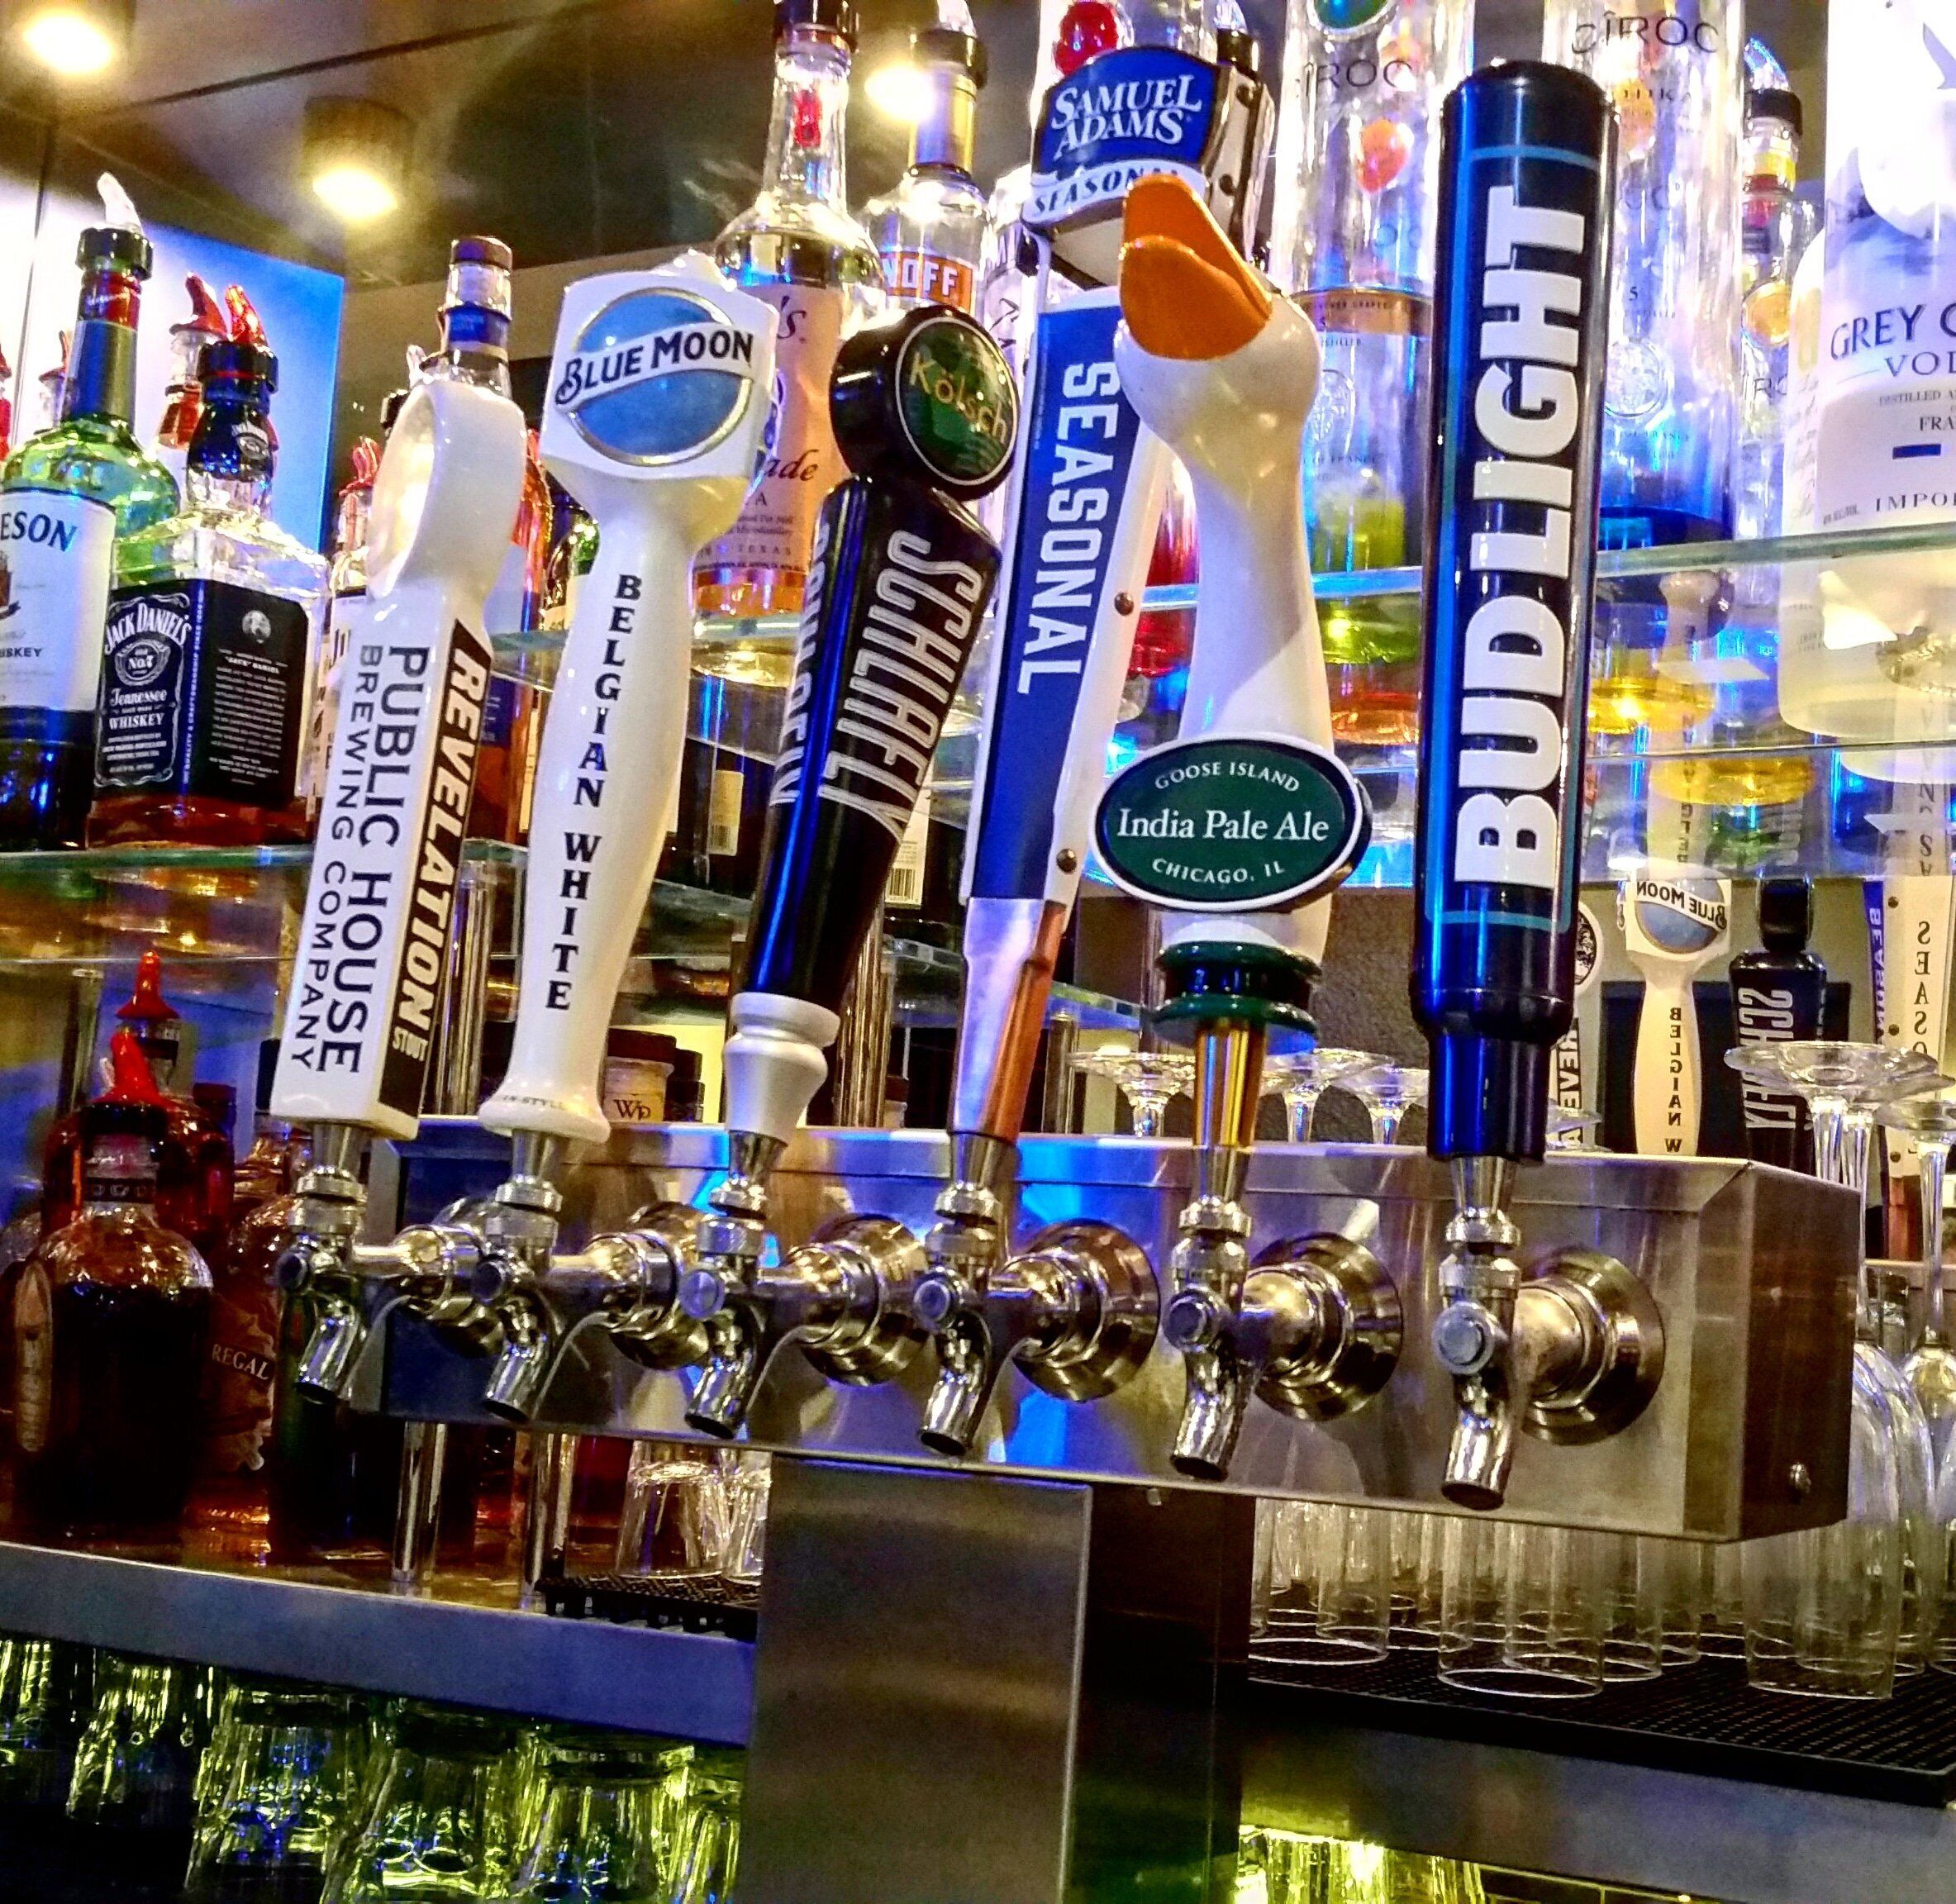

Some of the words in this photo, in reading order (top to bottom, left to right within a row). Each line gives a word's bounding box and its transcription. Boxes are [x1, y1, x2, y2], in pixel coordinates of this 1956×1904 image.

[1051, 74, 1202, 130] SAMUEL
[1053, 107, 1185, 162] ADAMS
[1035, 167, 1178, 213] SEASON
[554, 345, 645, 406] BLUE
[651, 330, 754, 369] MOON
[1830, 303, 1927, 360] GREY
[1471, 185, 1587, 578] LIGHT
[1016, 361, 1121, 695] SEASONAL
[104, 612, 136, 655] JACK
[136, 602, 193, 646] DANIEL'S
[108, 712, 165, 731] WHISKEY
[109, 688, 167, 707] Tennessee
[574, 574, 643, 809] BELGIAN
[816, 529, 984, 844] SCHLAFLY
[331, 645, 384, 841] BREWING
[358, 645, 430, 849] PUBLIC
[1154, 761, 1222, 790] GOOSE
[1229, 761, 1301, 793] ISLAND
[1454, 593, 1568, 888] BUD
[396, 647, 486, 1033] REVELATION
[1116, 807, 1196, 839] India
[1202, 809, 1268, 840] Pale
[1273, 810, 1330, 841] Ale
[1264, 860, 1286, 878] IL
[545, 831, 602, 1011] WHITE
[292, 860, 347, 1069] COMPANY
[316, 871, 393, 1073] HOUSE
[212, 1343, 269, 1381] REGAL
